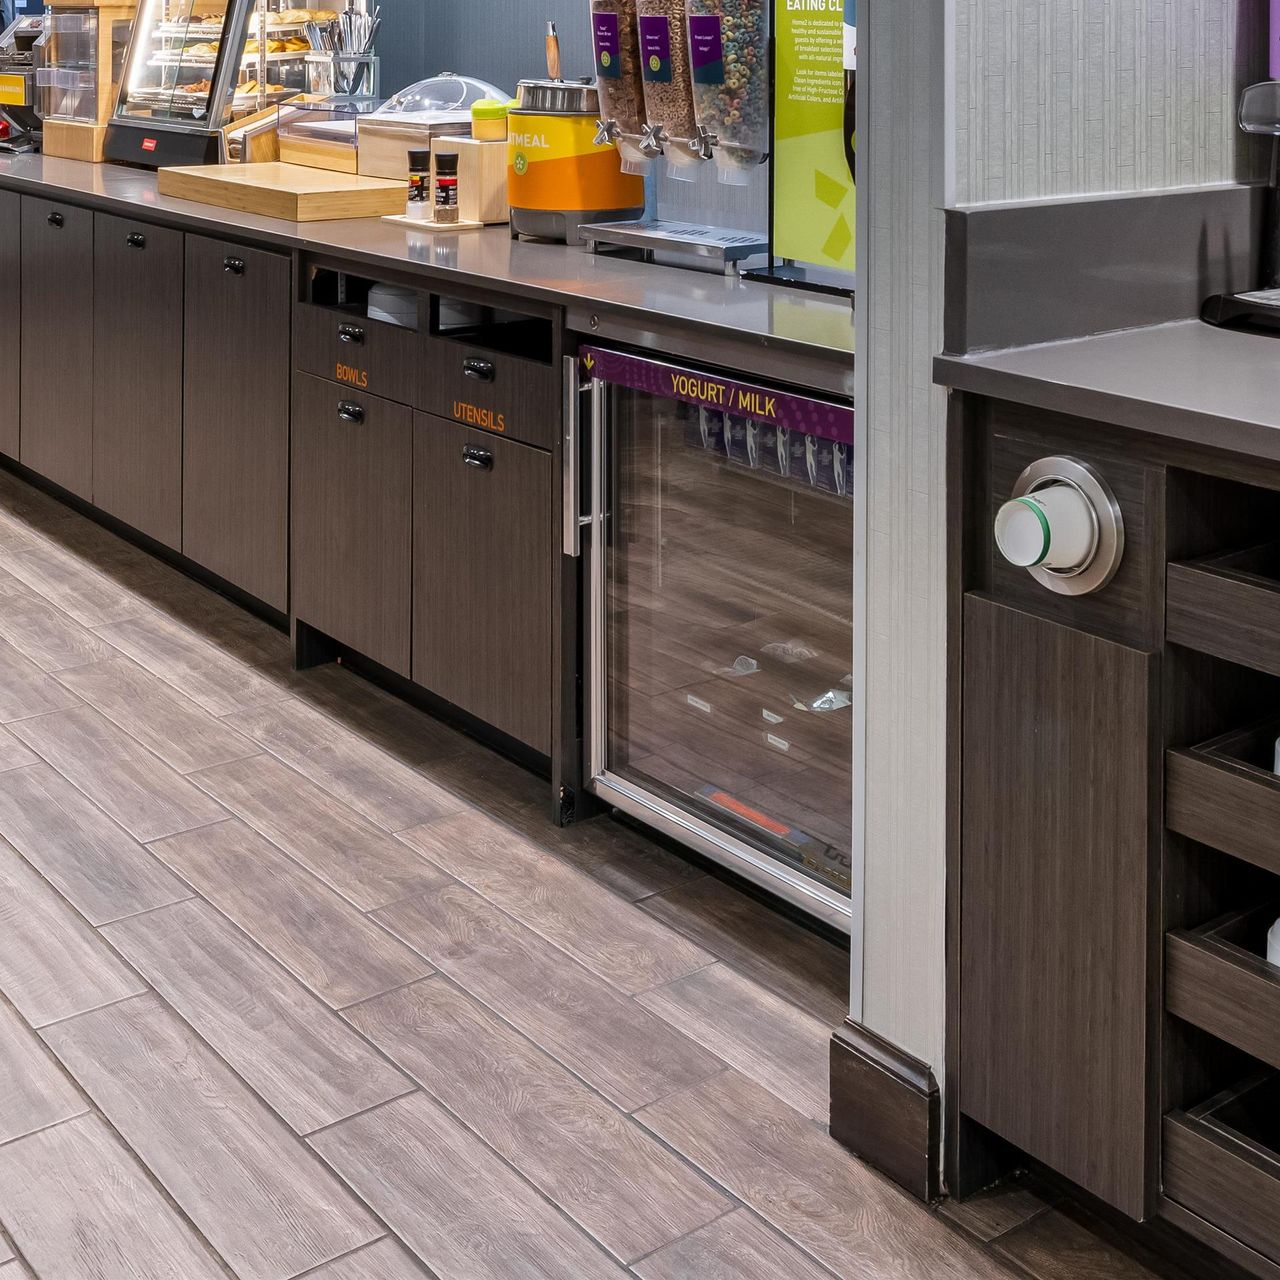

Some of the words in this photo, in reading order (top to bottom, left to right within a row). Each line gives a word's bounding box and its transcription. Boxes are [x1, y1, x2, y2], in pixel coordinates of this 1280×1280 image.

[510, 131, 550, 148] TMEAL
[336, 362, 368, 388] BOWLS
[671, 373, 726, 405] YOGURT
[728, 388, 735, 407] /
[739, 390, 776, 418] MILK
[453, 400, 505, 432] UTENSILS
